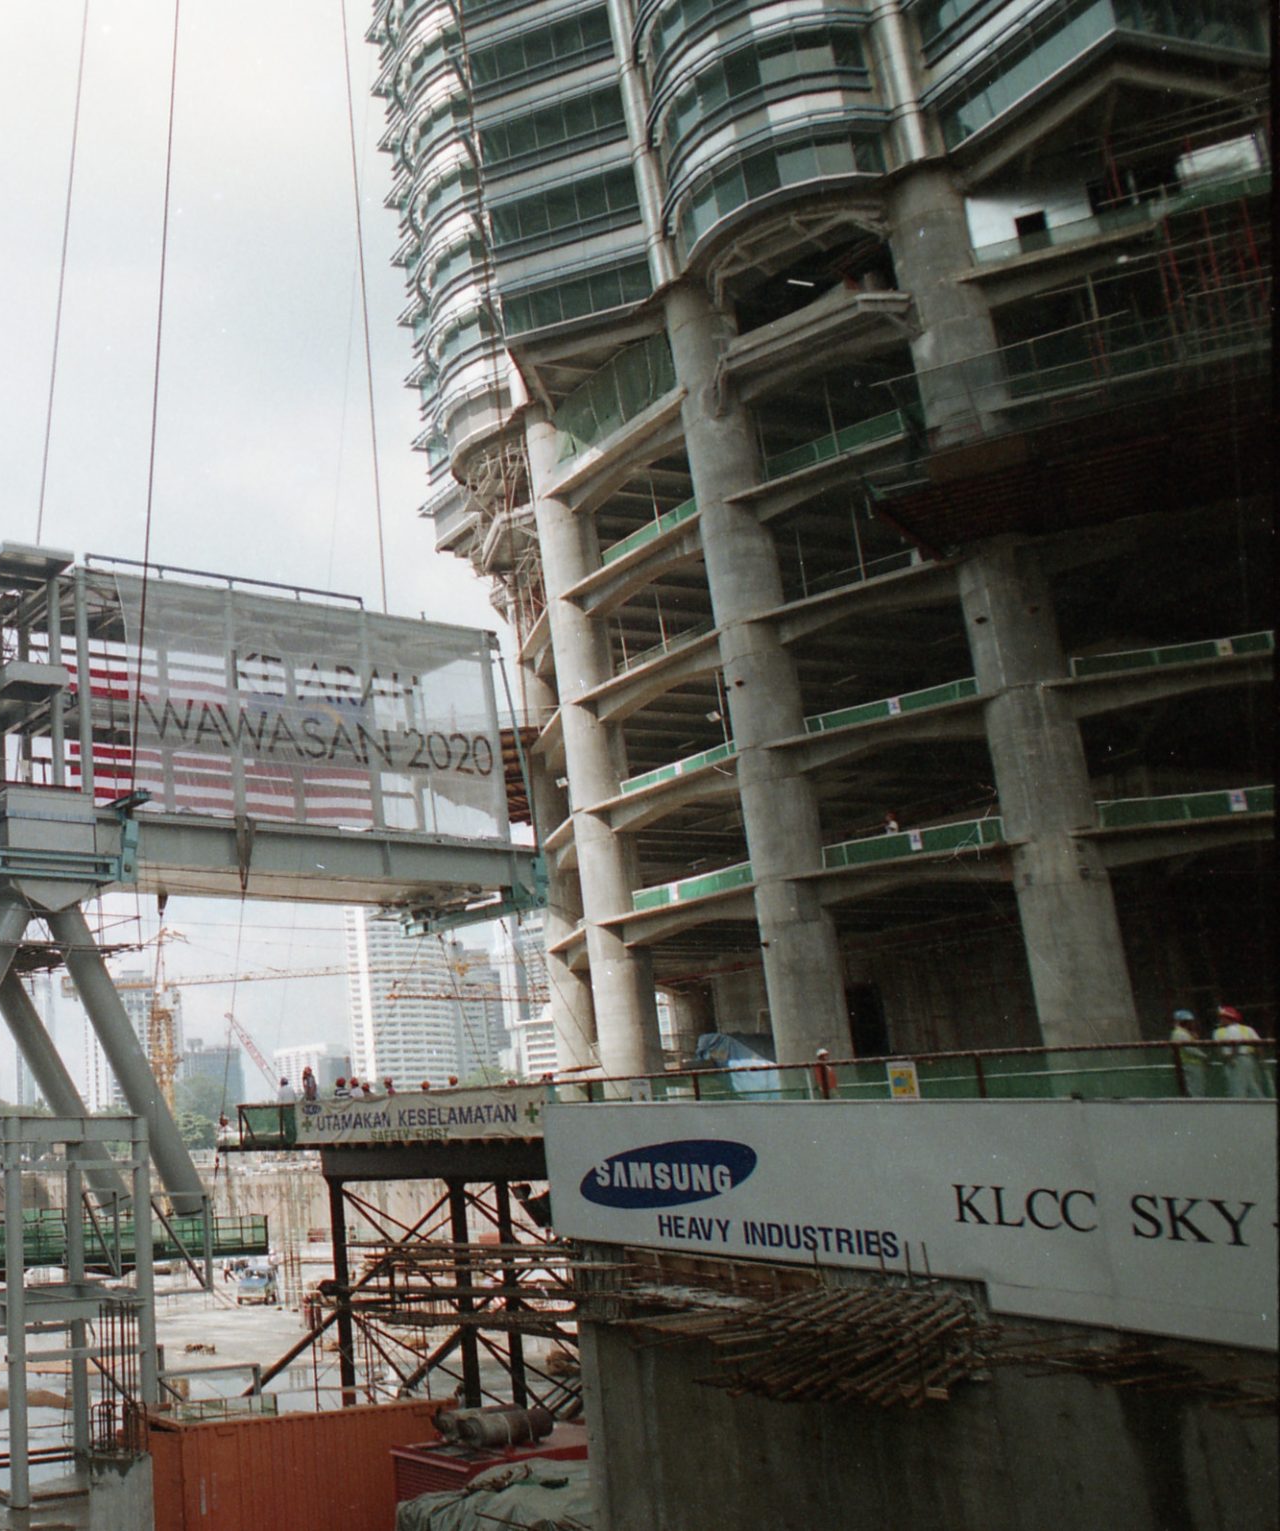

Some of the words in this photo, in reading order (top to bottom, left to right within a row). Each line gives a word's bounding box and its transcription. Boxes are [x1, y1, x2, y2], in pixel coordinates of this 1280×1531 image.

[137, 694, 392, 767] WAWASAN
[404, 727, 494, 776] 2020
[316, 1110, 391, 1132] UTAMAKAN
[398, 1103, 518, 1127] KESELAMATAN
[370, 1128, 410, 1140] SAFETY
[415, 1127, 450, 1139] FIRST
[594, 1161, 732, 1193] SAMSUNG
[952, 1184, 1098, 1233] KLCC
[1132, 1195, 1257, 1247] SKY
[658, 1214, 732, 1244] HEAVY
[744, 1220, 900, 1259] INDUSTRIES
